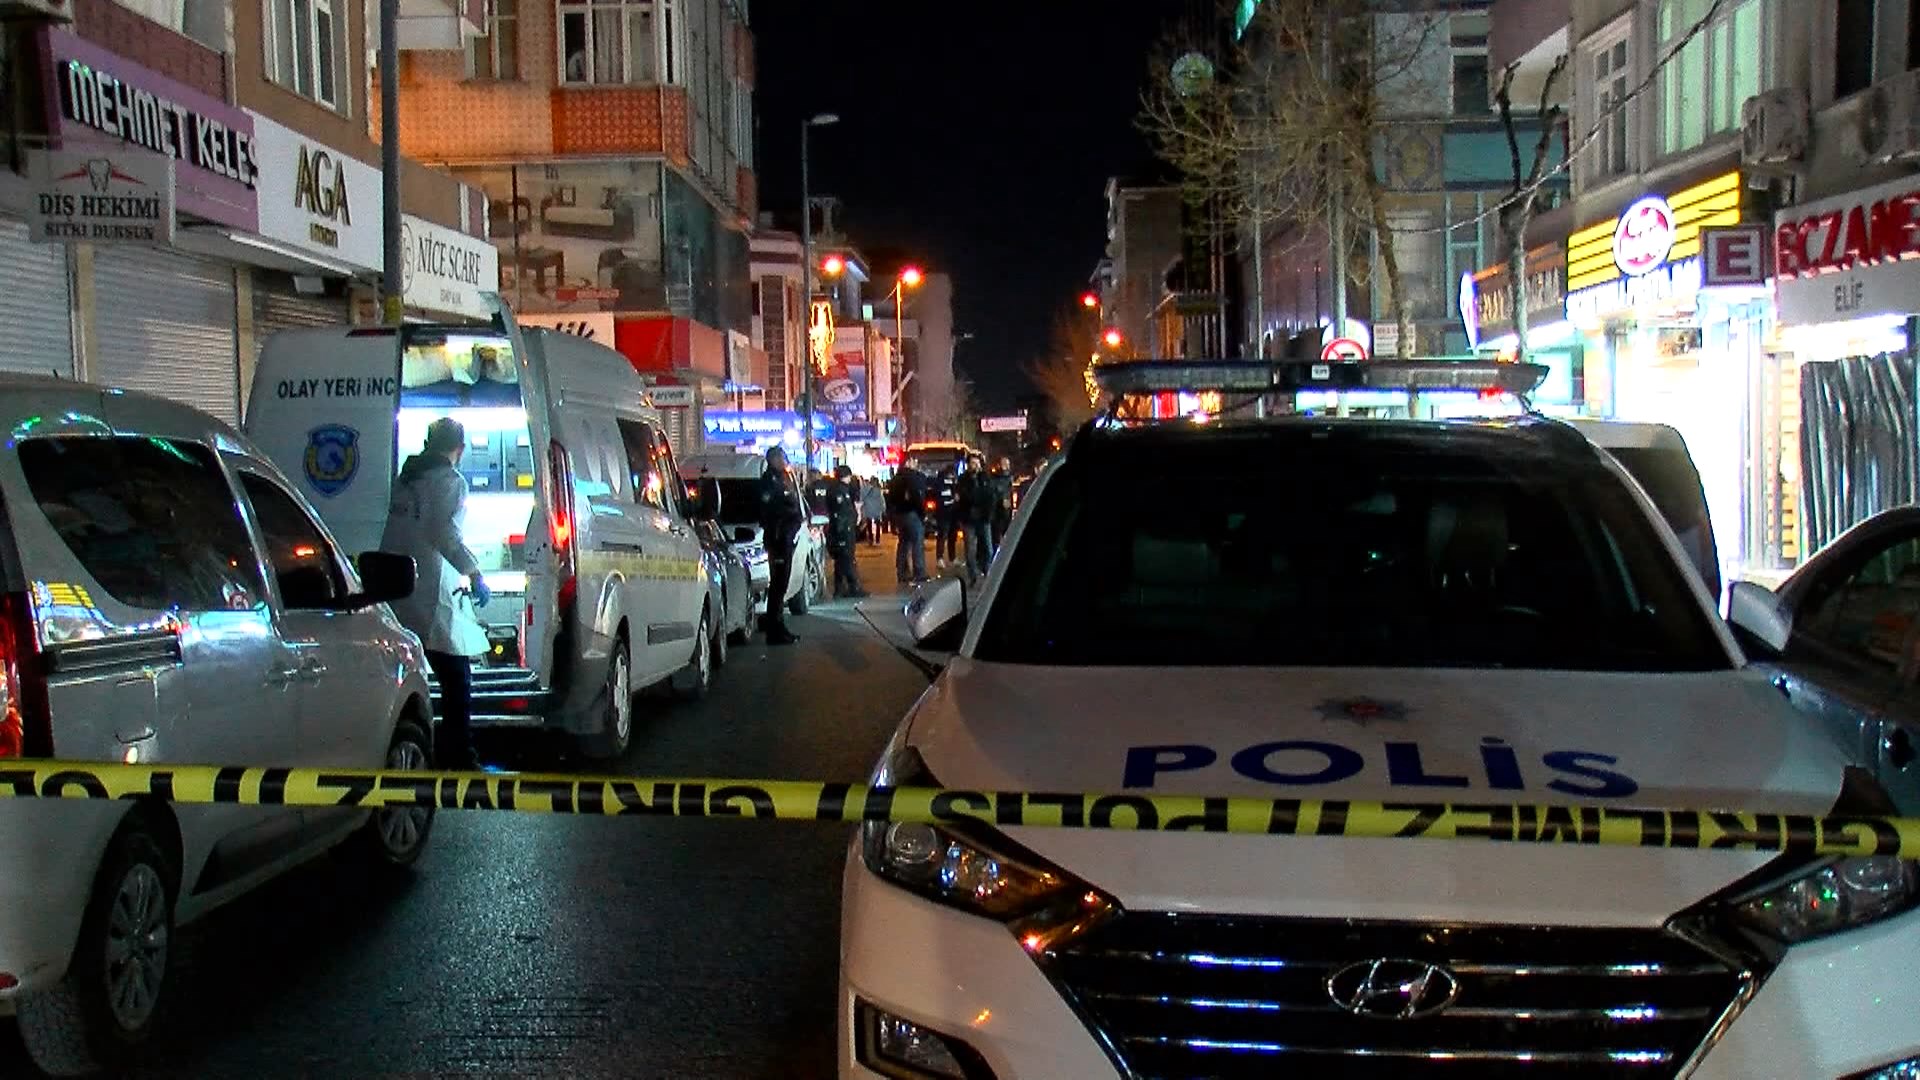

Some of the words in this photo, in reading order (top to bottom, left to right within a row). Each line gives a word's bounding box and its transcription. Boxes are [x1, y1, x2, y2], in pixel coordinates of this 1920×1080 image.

[66, 59, 188, 160] MEHMET
[38, 187, 75, 221] DİŞ
[80, 190, 160, 219] HEKİMİ
[295, 145, 351, 226] AGA
[92, 223, 153, 239] DURSUN
[1776, 190, 1920, 281] ECZANE
[417, 231, 447, 278] NİCE
[448, 245, 481, 287] SCARF
[1716, 237, 1751, 276] E
[1834, 276, 1863, 311] ELİF
[277, 379, 319, 399] OLAY
[1122, 736, 1639, 798] POLİS
